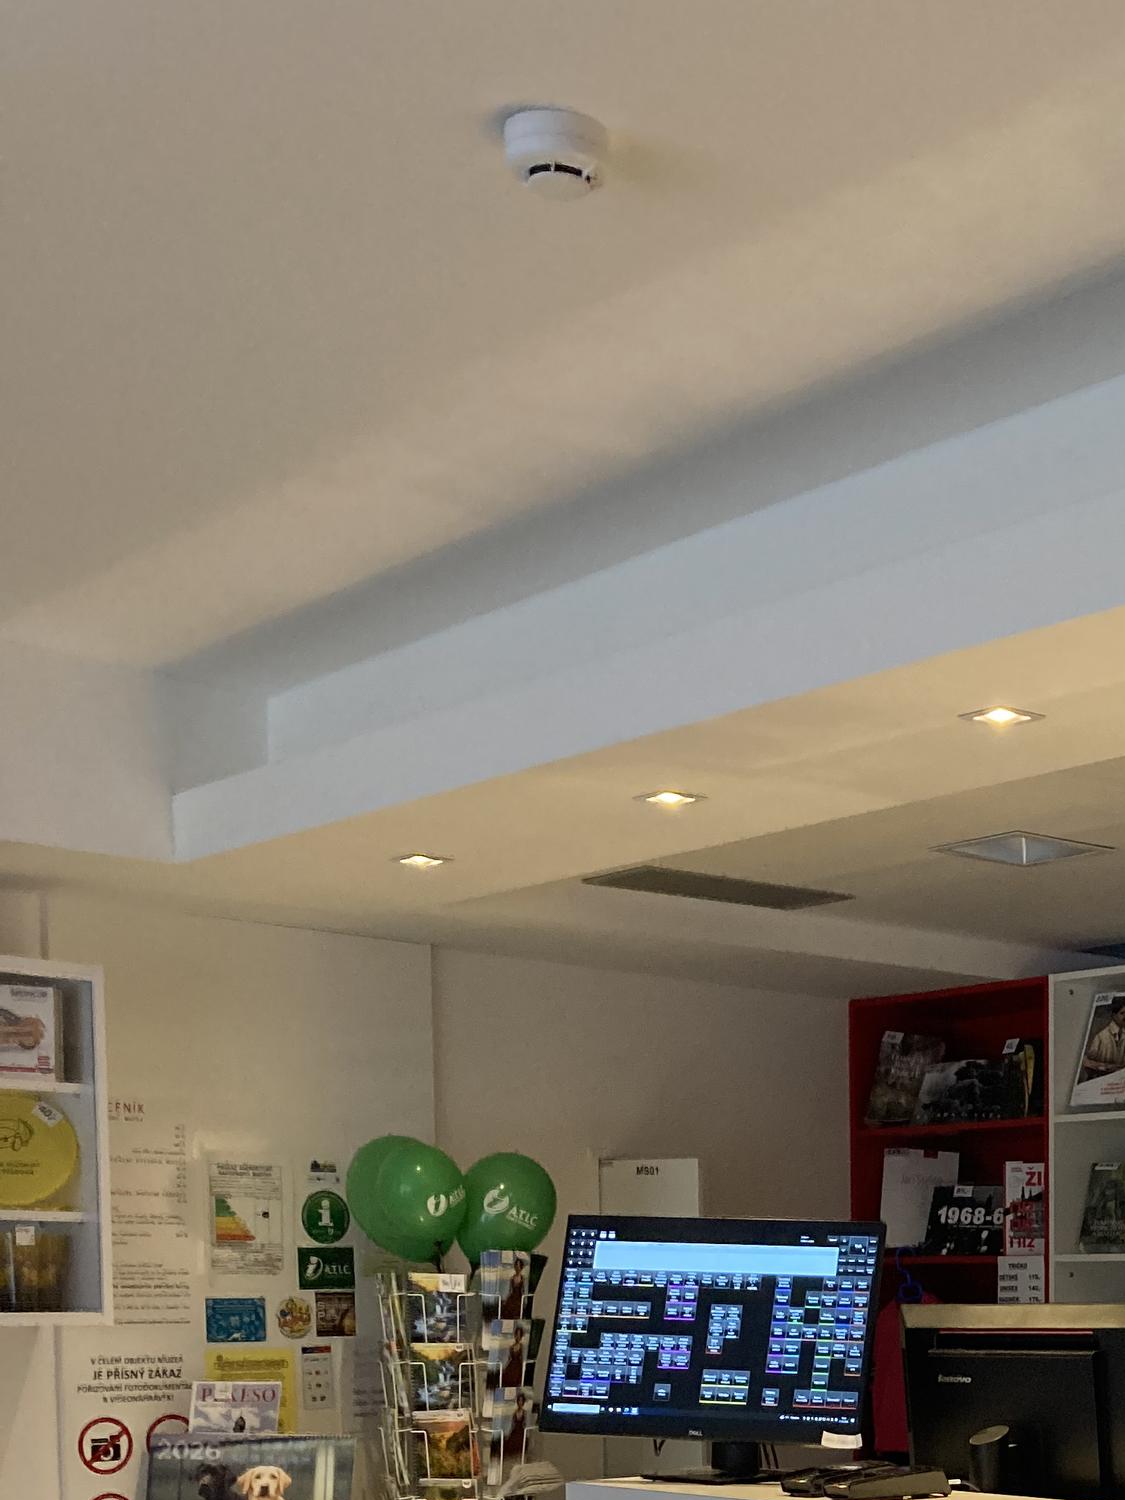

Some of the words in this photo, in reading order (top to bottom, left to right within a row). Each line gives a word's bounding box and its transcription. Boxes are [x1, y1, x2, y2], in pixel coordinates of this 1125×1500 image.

[636, 1166, 659, 1176] MS01
[93, 1370, 103, 1381] JE
[107, 1367, 145, 1381] PŘÍSNÝ
[148, 1367, 182, 1380] ZÁKAZ
[201, 1387, 276, 1403] PESO
